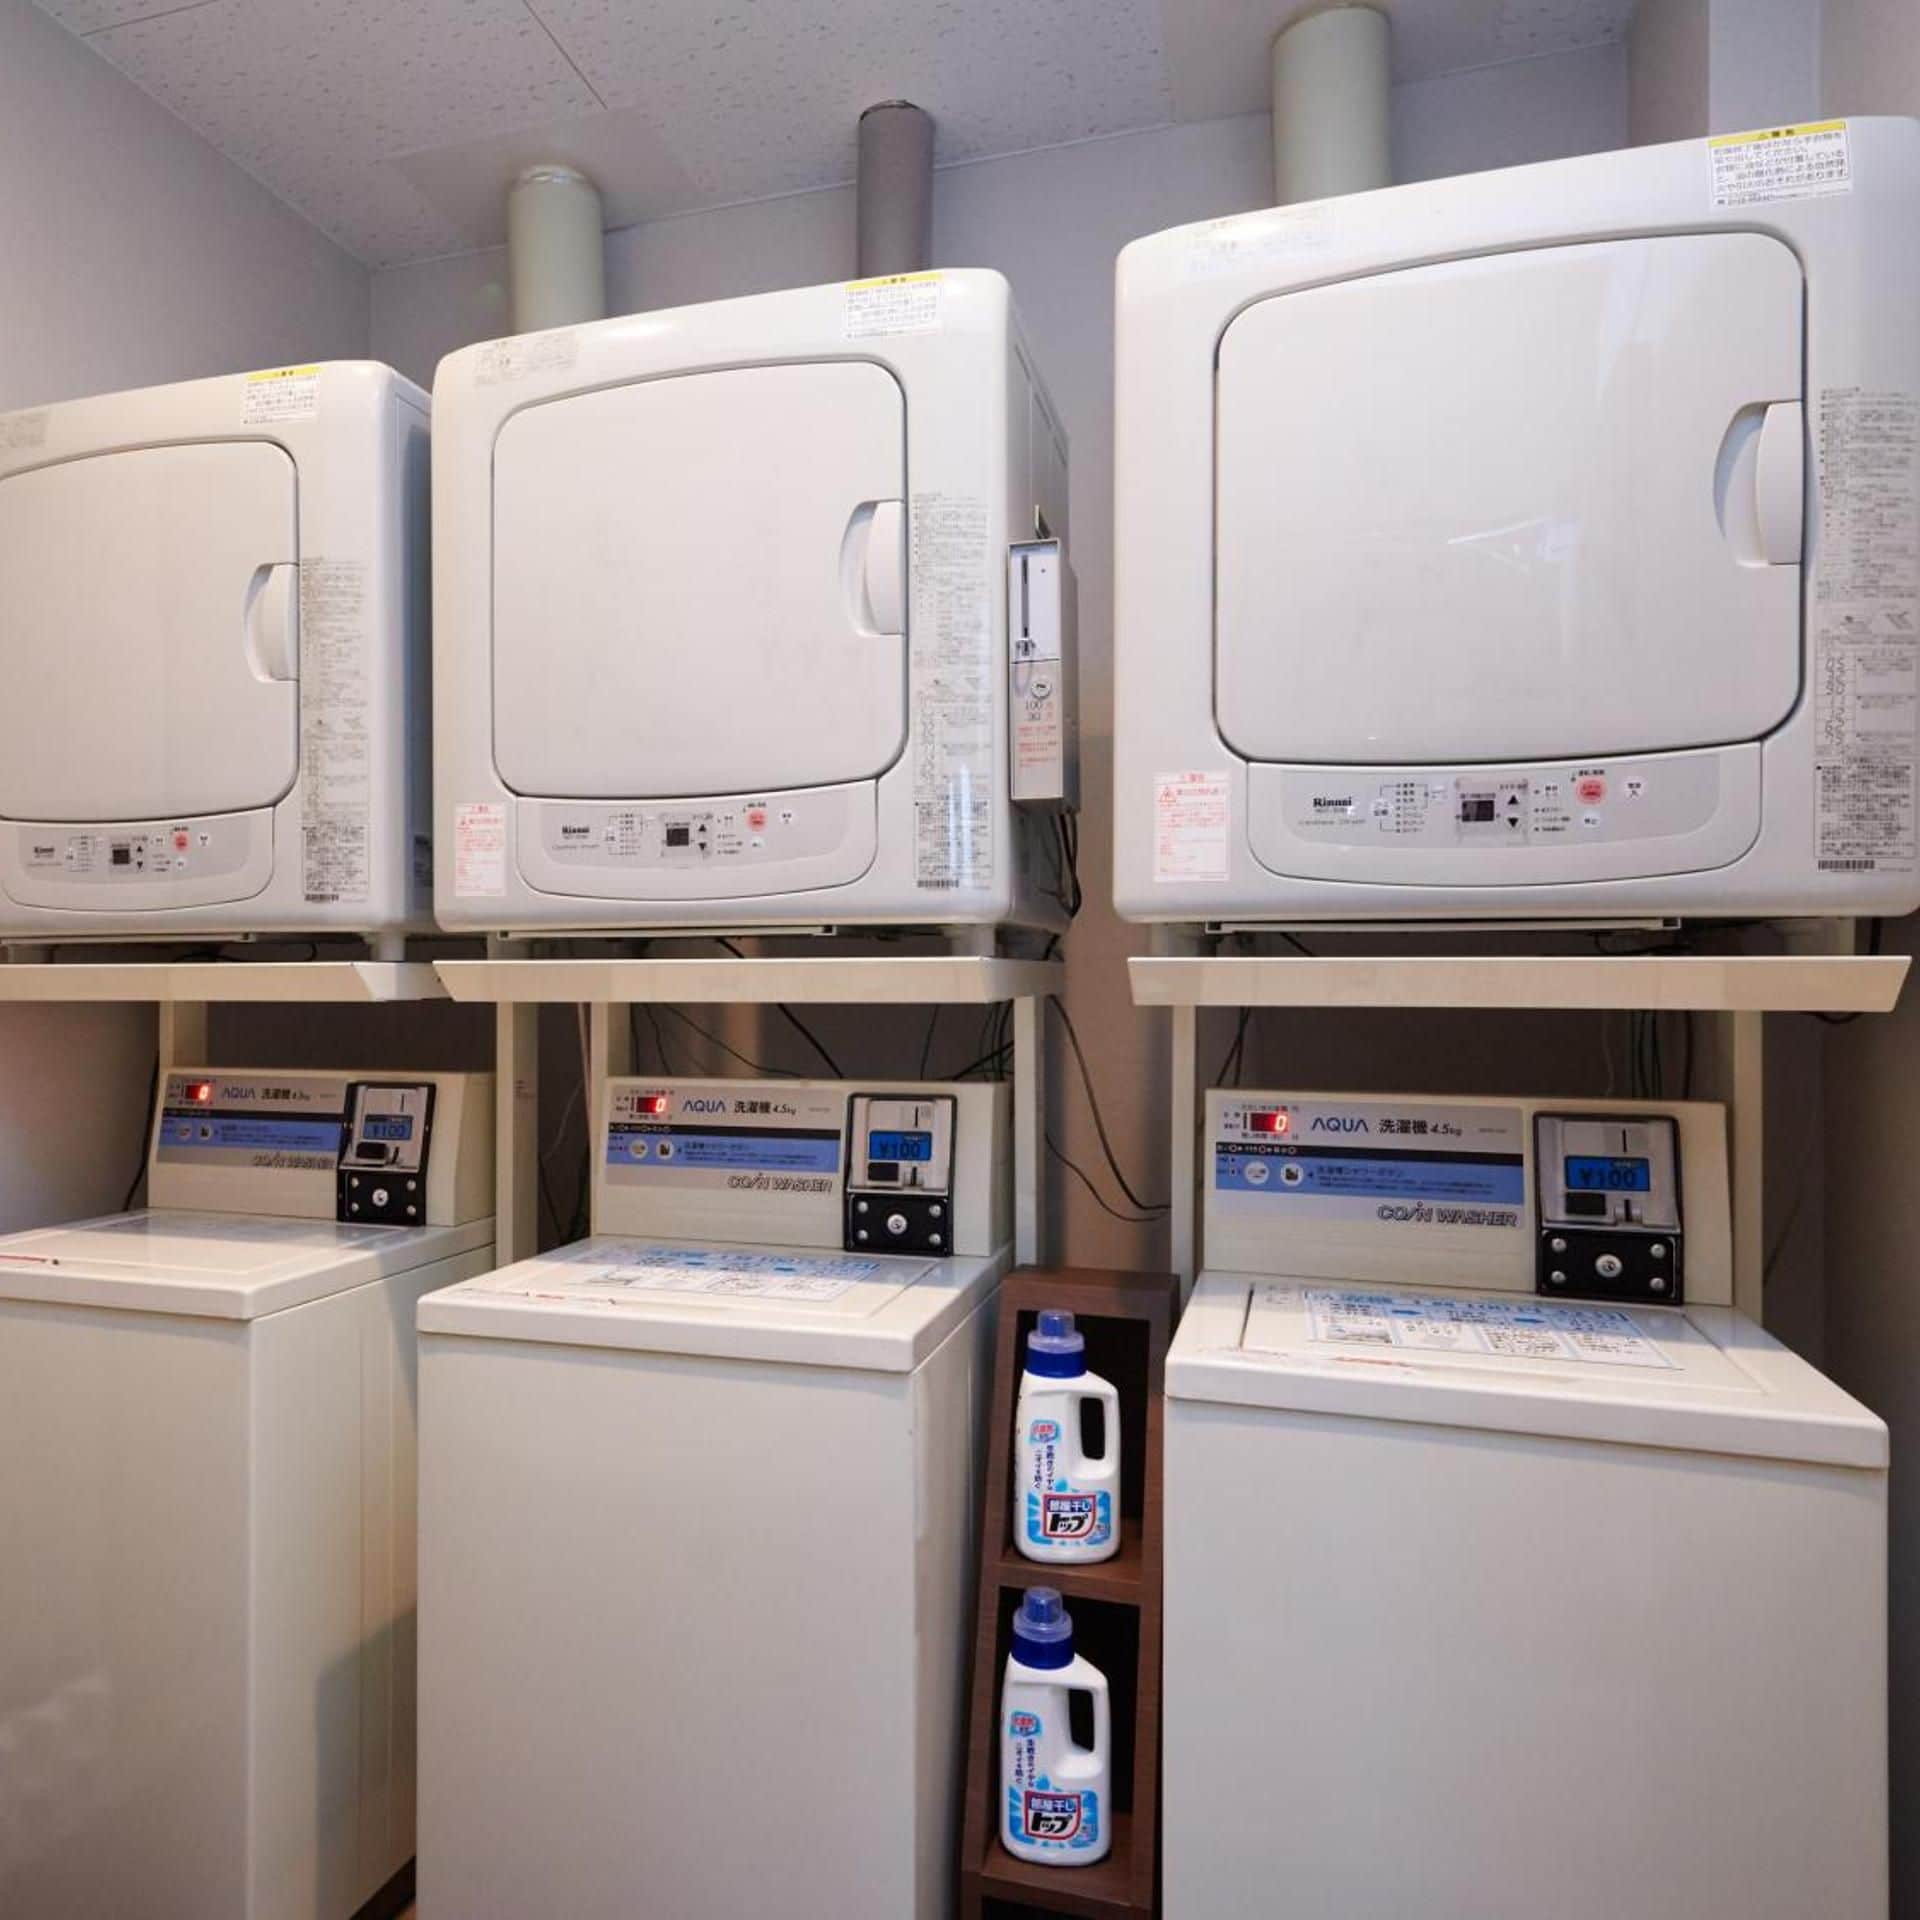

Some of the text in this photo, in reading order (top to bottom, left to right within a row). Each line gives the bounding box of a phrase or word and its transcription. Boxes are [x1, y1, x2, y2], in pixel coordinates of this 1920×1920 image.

[1313, 796, 1352, 808] Rinnai
[222, 1087, 256, 1099] AQUA
[655, 1097, 666, 1112] 0
[682, 1100, 726, 1113] AQUA
[734, 1101, 772, 1114] 洗濯機
[1275, 1114, 1288, 1131] 0
[1311, 1116, 1369, 1132] AQUA
[1379, 1119, 1428, 1134] 洗濯機
[1430, 1122, 1462, 1137] 4.5kg
[1377, 1200, 1517, 1227] COIN WASHER
[1050, 1500, 1090, 1511] 部屋干し
[1049, 1513, 1088, 1533] トップ
[1031, 1798, 1075, 1811] 部屋干し
[1031, 1812, 1073, 1833] トップ
